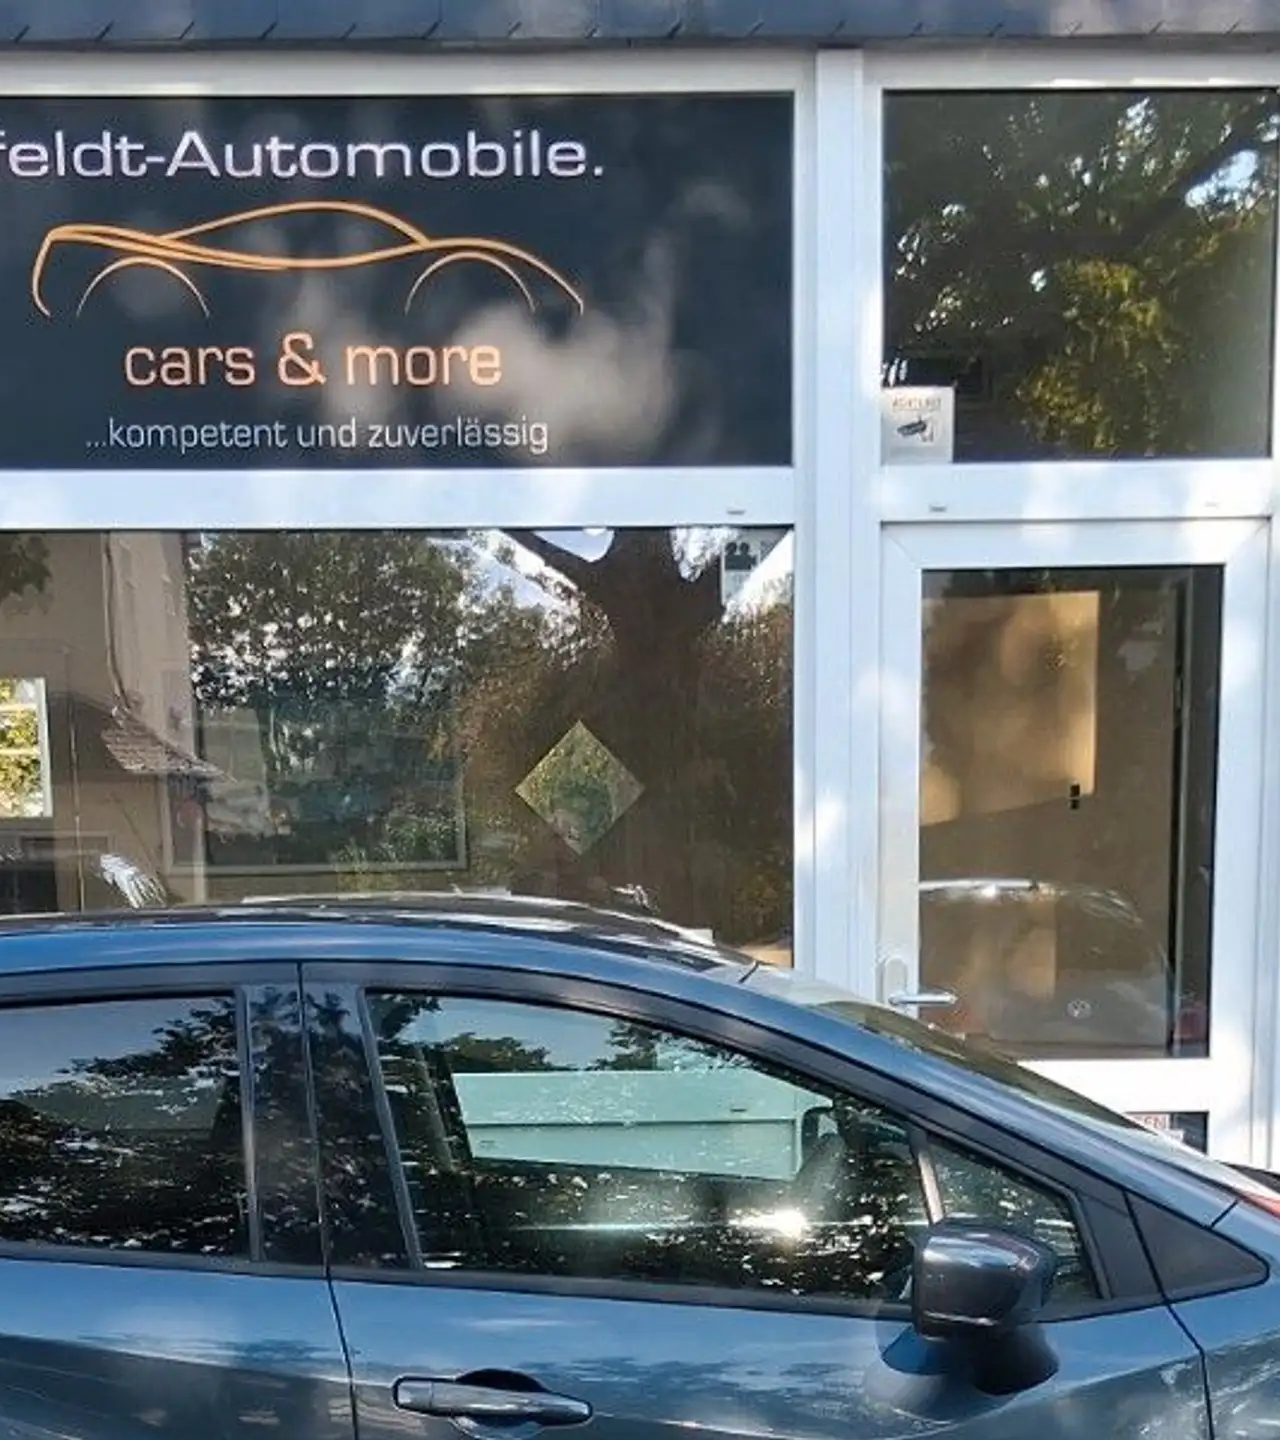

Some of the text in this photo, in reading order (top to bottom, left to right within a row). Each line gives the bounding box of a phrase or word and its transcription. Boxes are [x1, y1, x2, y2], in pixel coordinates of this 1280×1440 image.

[124, 331, 502, 387] cars & more
[297, 417, 358, 449] und
[367, 417, 548, 454] zuverlässig
